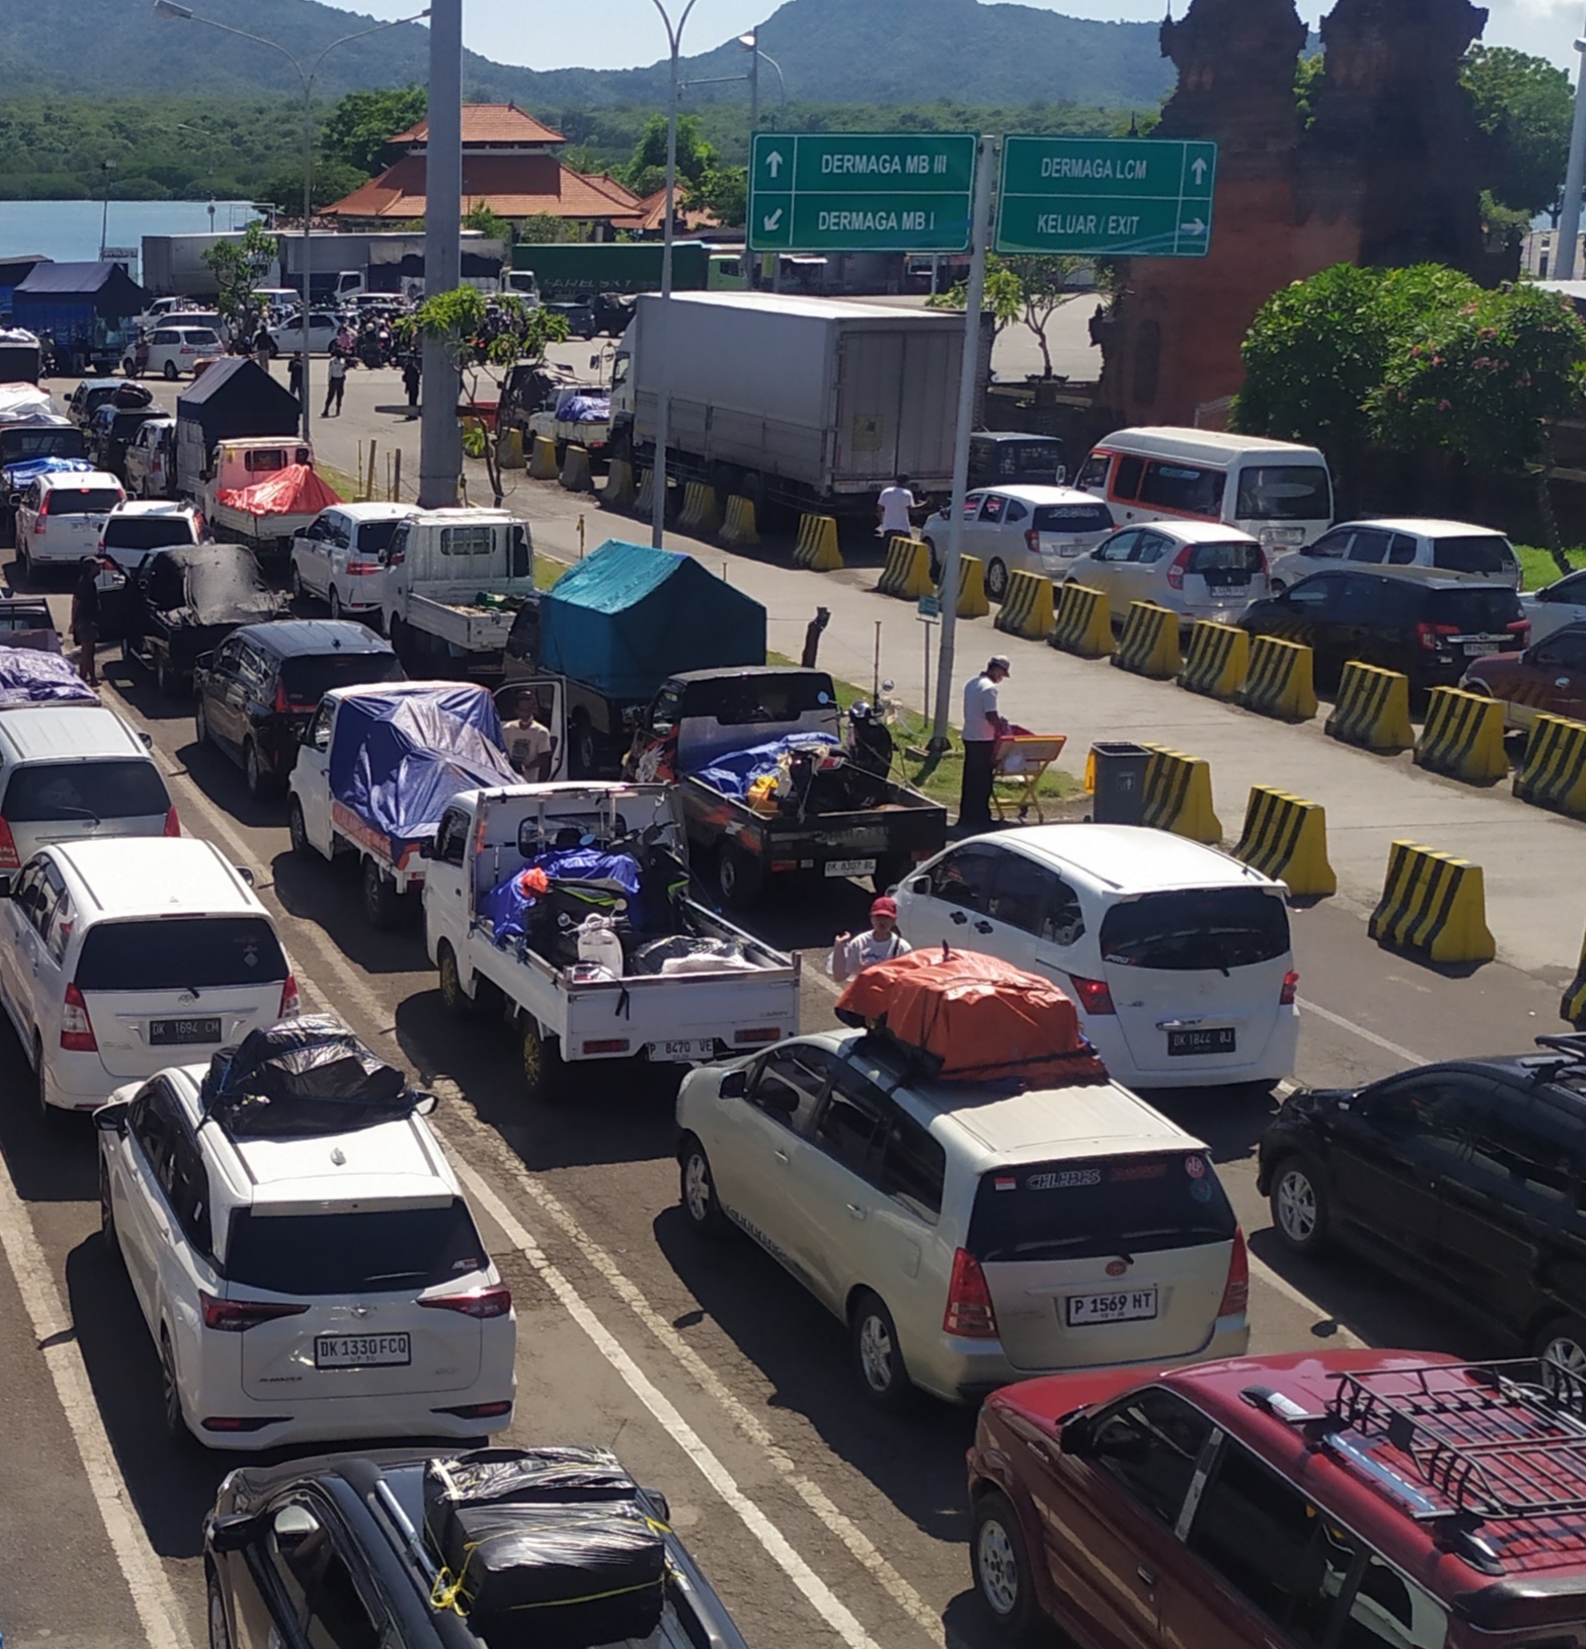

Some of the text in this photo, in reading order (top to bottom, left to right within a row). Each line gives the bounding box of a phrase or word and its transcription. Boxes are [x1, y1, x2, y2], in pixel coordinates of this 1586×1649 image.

[821, 154, 947, 174] DERMAGA MB III
[1041, 157, 1147, 180] DERMAGA LCM
[818, 211, 935, 231] DERMAGA MB I
[1037, 214, 1097, 234] KELUAR
[1107, 215, 1140, 235] EXIT
[152, 1020, 220, 1036] DK 1694 CM
[649, 1039, 712, 1056] P 8470 VE
[1074, 1292, 1152, 1316] P 1569 HT
[319, 1336, 408, 1358] DK 1330 FCQ
